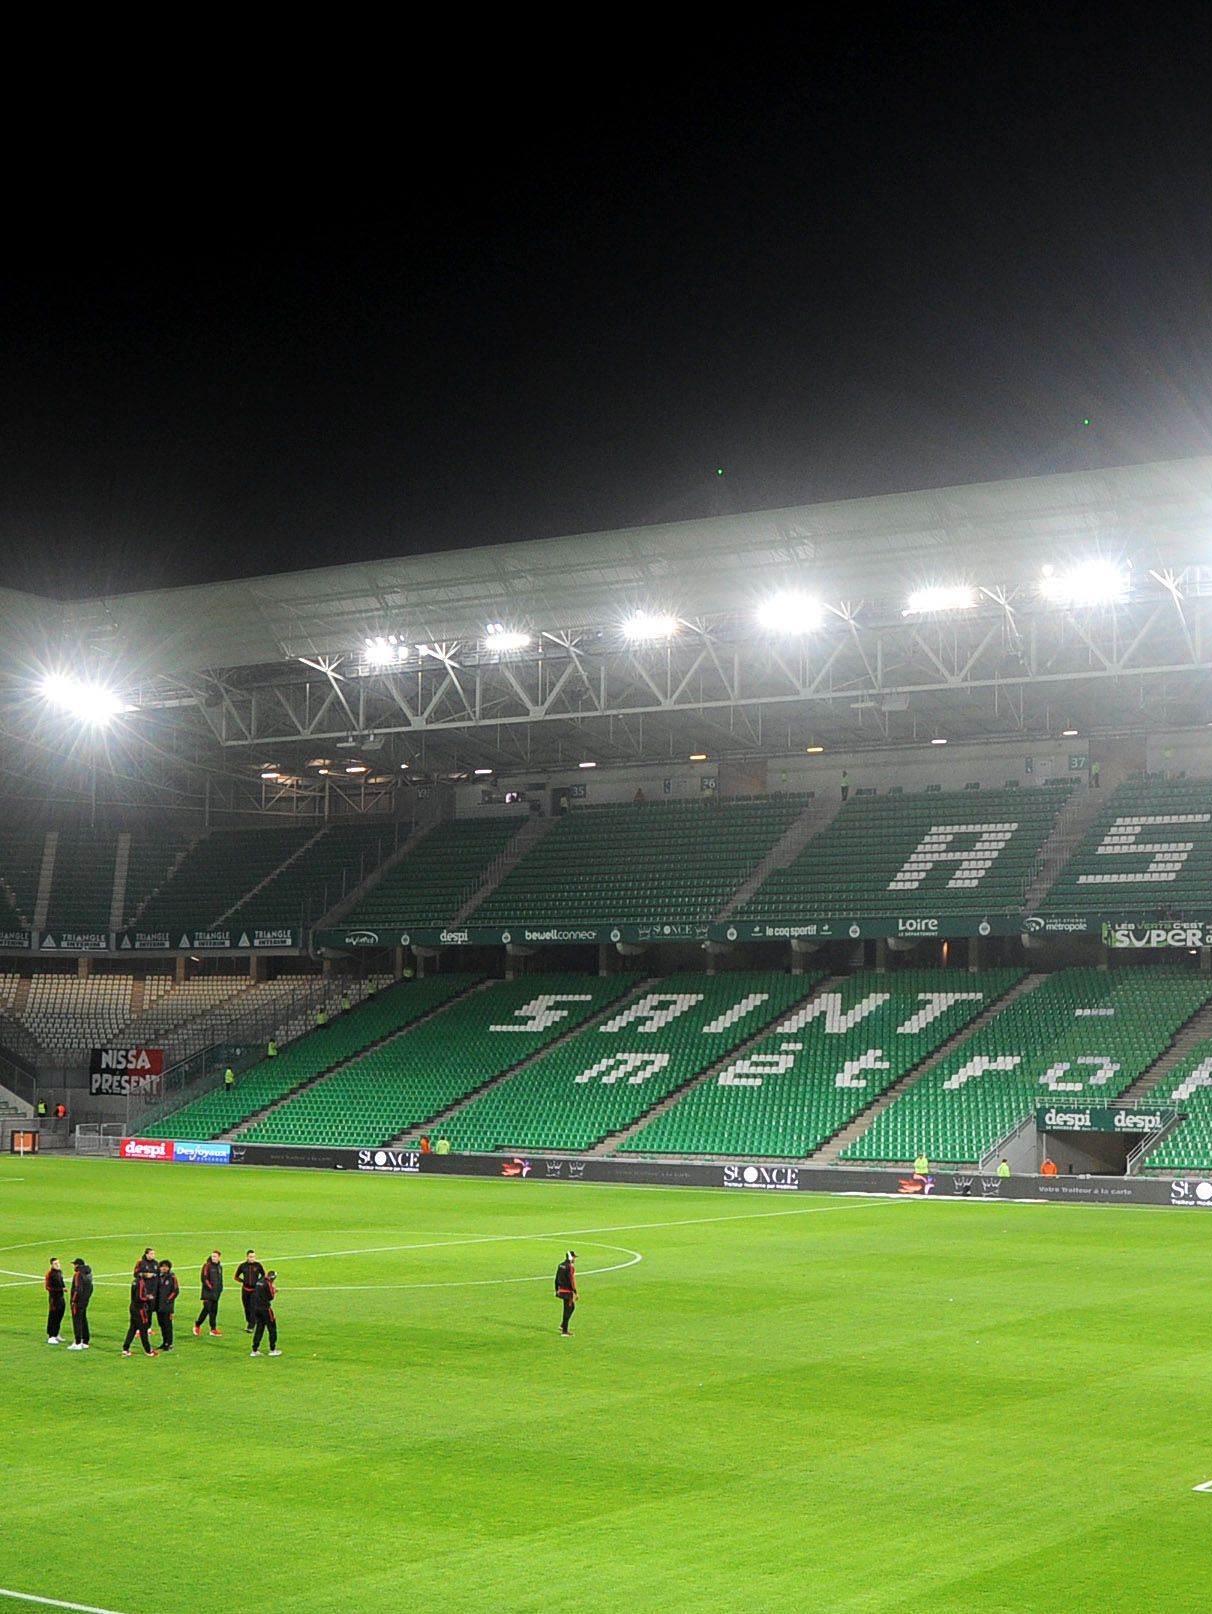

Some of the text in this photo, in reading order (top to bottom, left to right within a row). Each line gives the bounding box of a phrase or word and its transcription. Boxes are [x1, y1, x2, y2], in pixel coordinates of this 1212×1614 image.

[1071, 758, 1085, 768] 37
[774, 926, 790, 938] coq
[790, 924, 817, 937] sportif
[898, 918, 939, 931] Loire
[62, 933, 106, 941] TRIANGLE
[195, 932, 230, 940] TRIANGLE
[255, 929, 292, 938] TRIANGLE
[440, 929, 468, 944] despi
[101, 1049, 152, 1070] NISSA
[1045, 1108, 1092, 1131] despi
[1114, 1110, 1162, 1132] despi
[125, 1141, 166, 1158] despi
[176, 1145, 227, 1161] Desjoyaux
